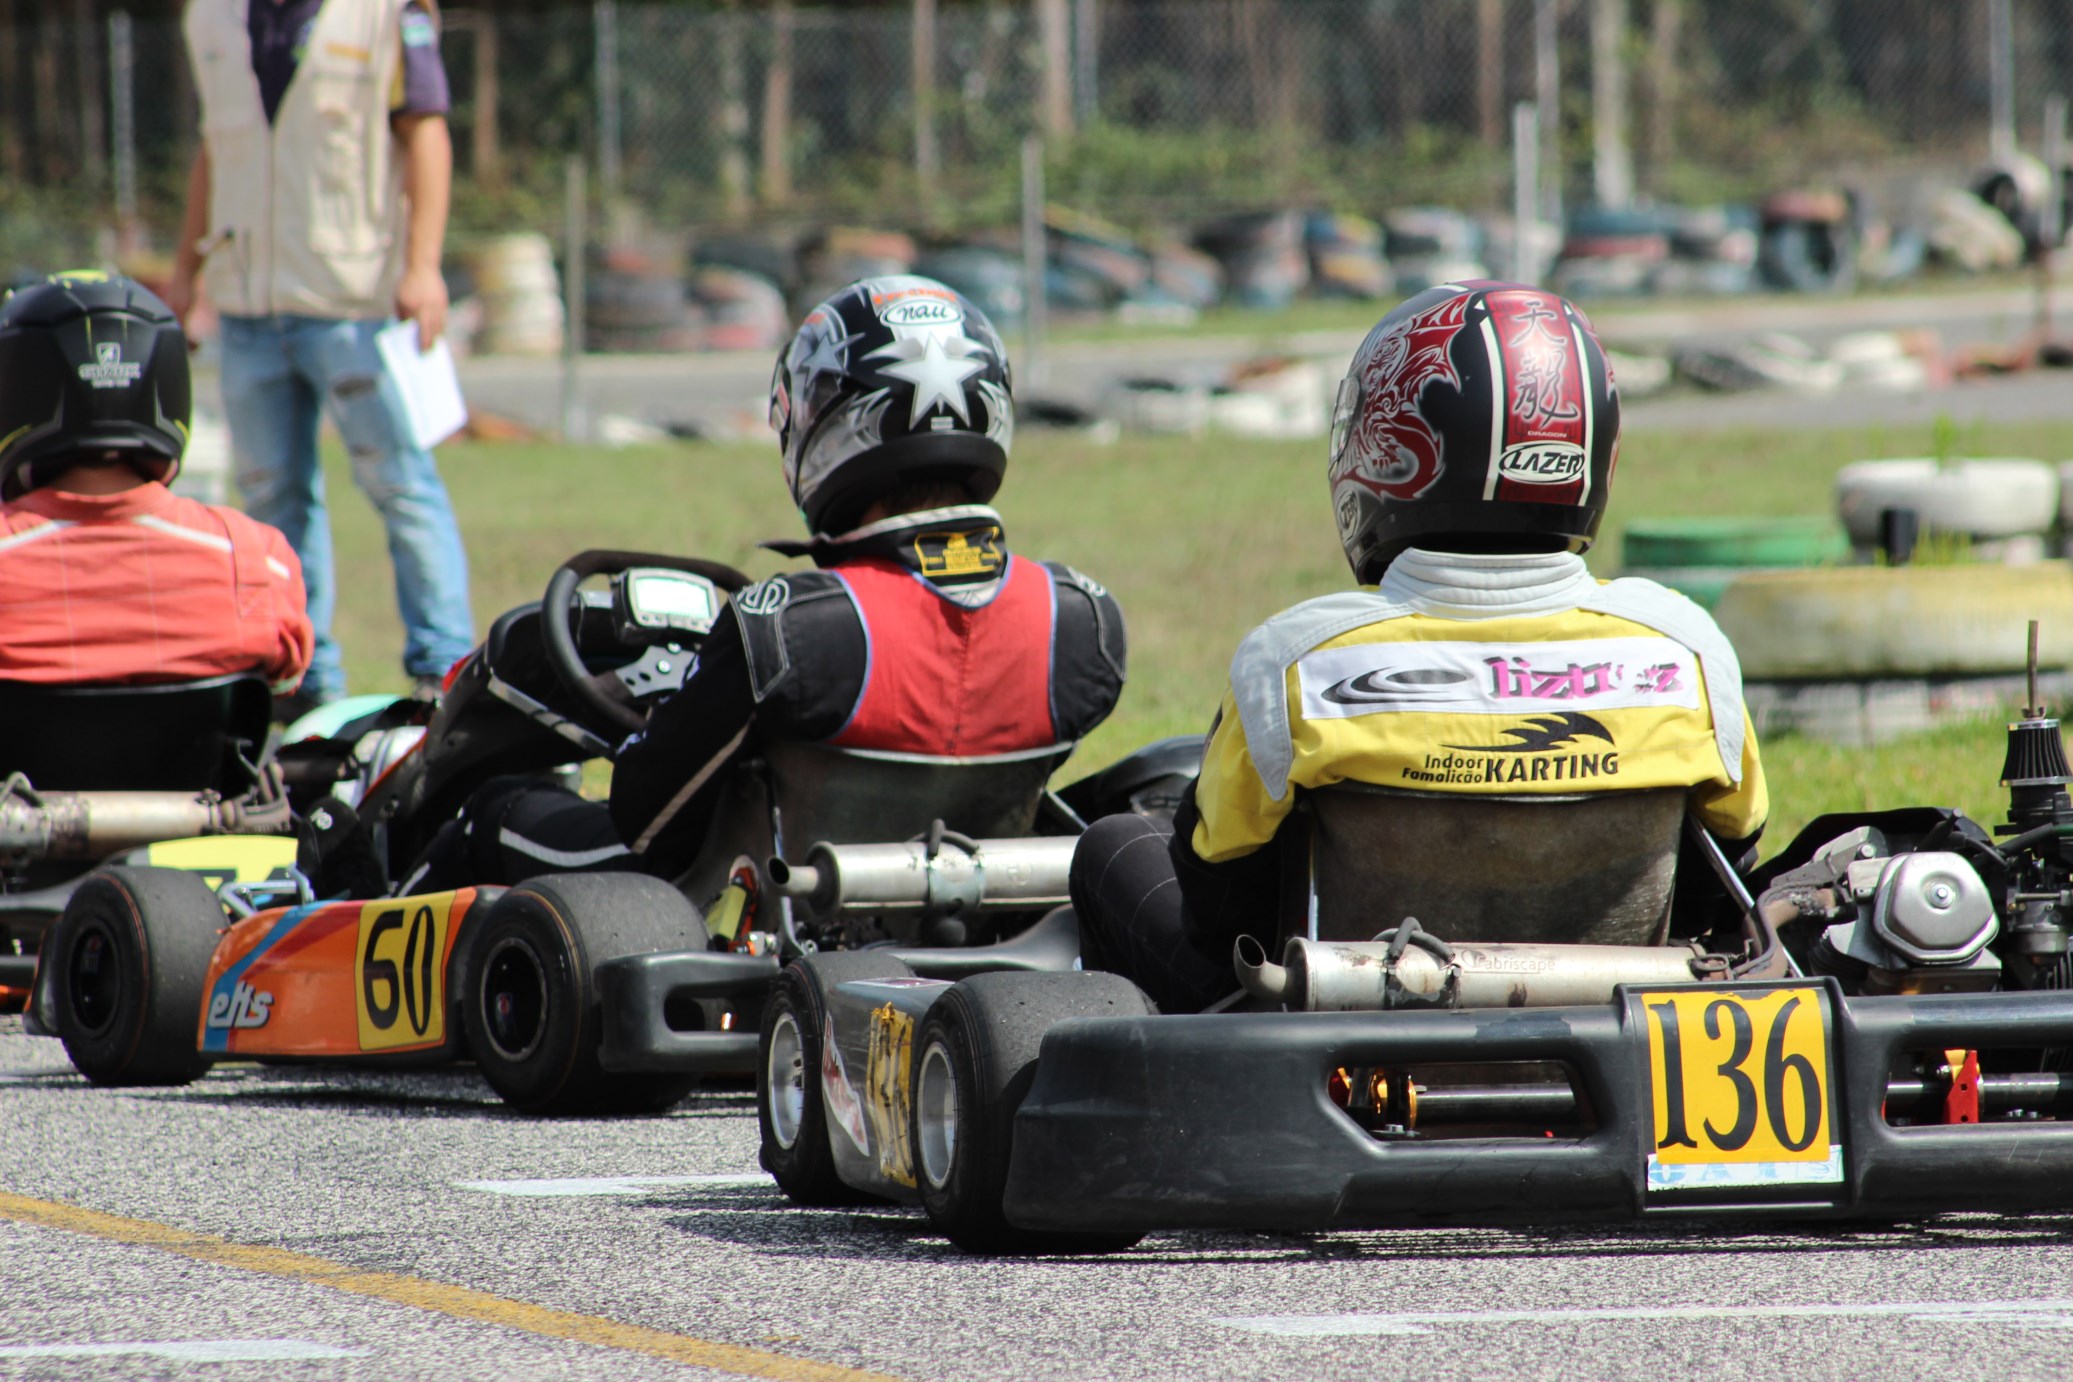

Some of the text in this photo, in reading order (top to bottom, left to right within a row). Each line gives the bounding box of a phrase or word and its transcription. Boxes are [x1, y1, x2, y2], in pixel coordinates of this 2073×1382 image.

[1527, 430, 1567, 438] DRAGON
[1508, 451, 1581, 475] LAZER
[1425, 752, 1484, 769] Indoor
[1484, 752, 1619, 783] KARTING
[1401, 767, 1483, 784] Famalicão
[363, 904, 436, 1037] 60
[1648, 996, 1822, 1152] 136
